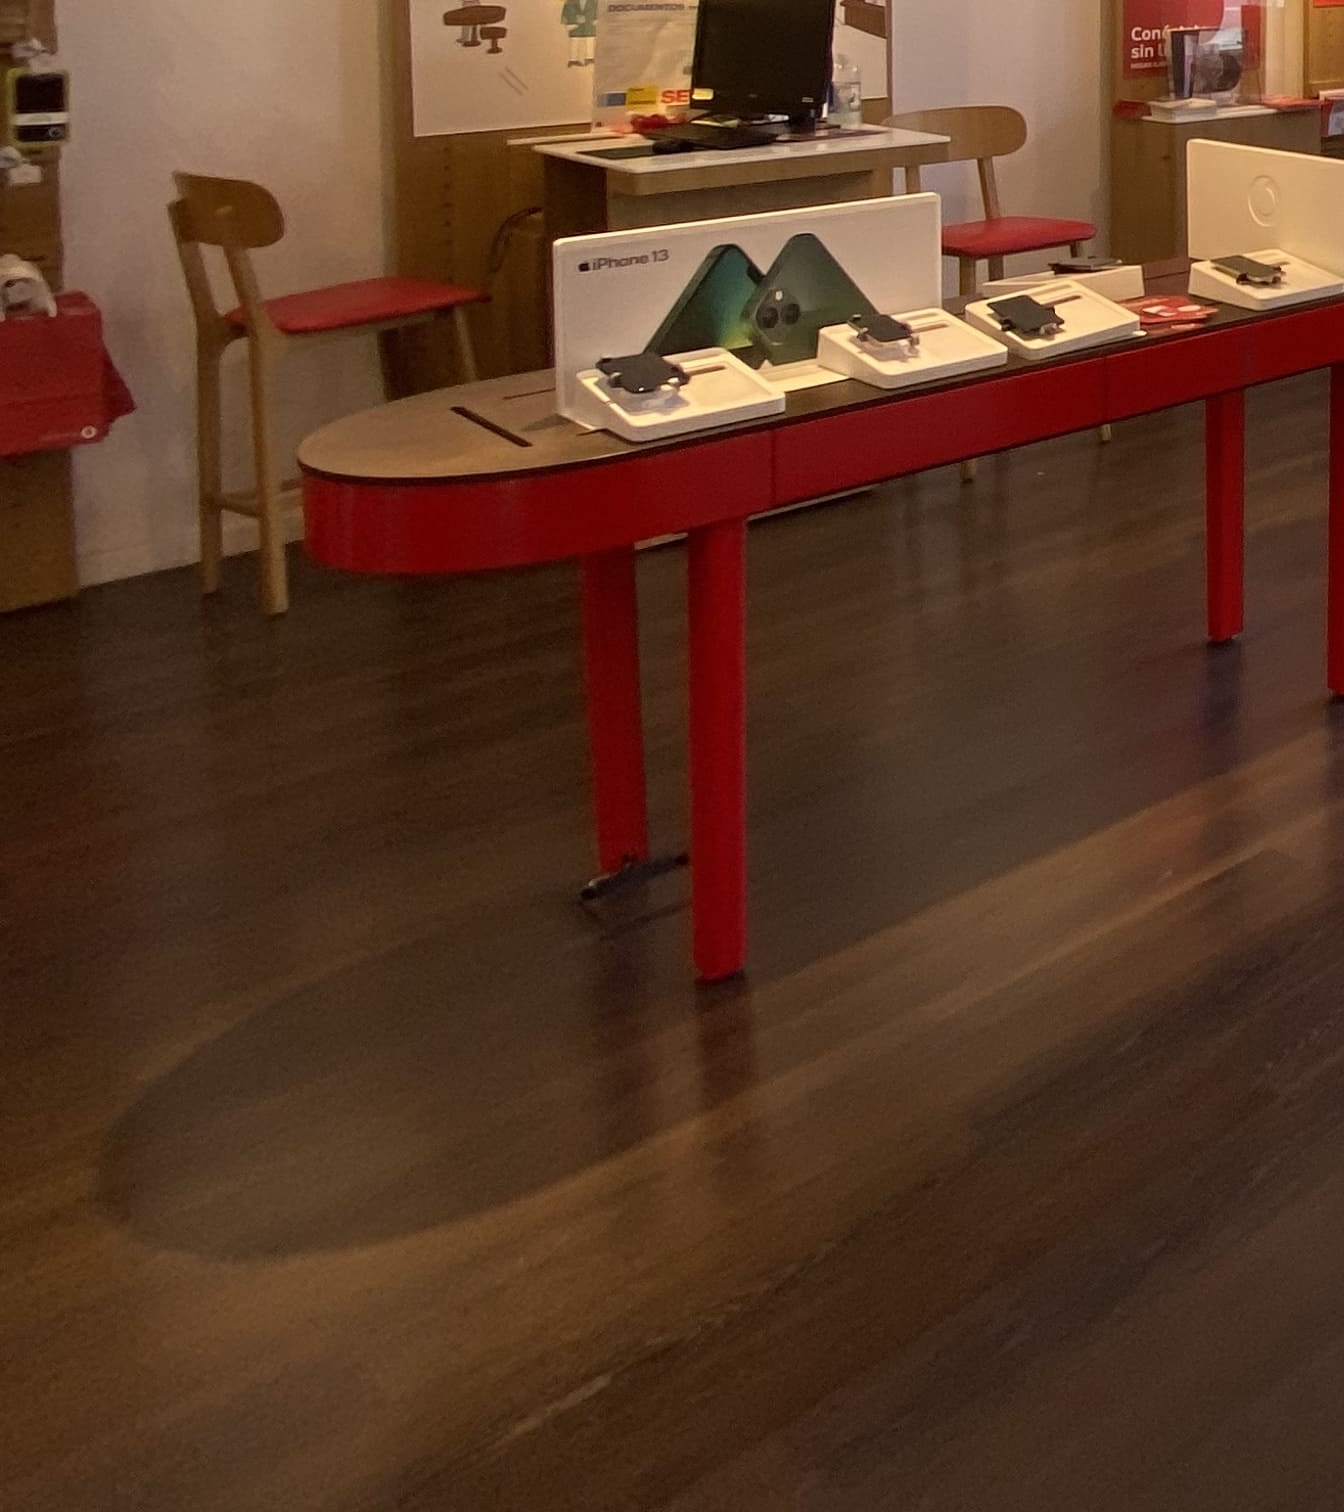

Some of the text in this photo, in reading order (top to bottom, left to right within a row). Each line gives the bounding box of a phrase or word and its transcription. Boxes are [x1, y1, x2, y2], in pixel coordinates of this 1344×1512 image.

[1131, 43, 1154, 59] sin
[592, 248, 670, 271] iPhone 13
